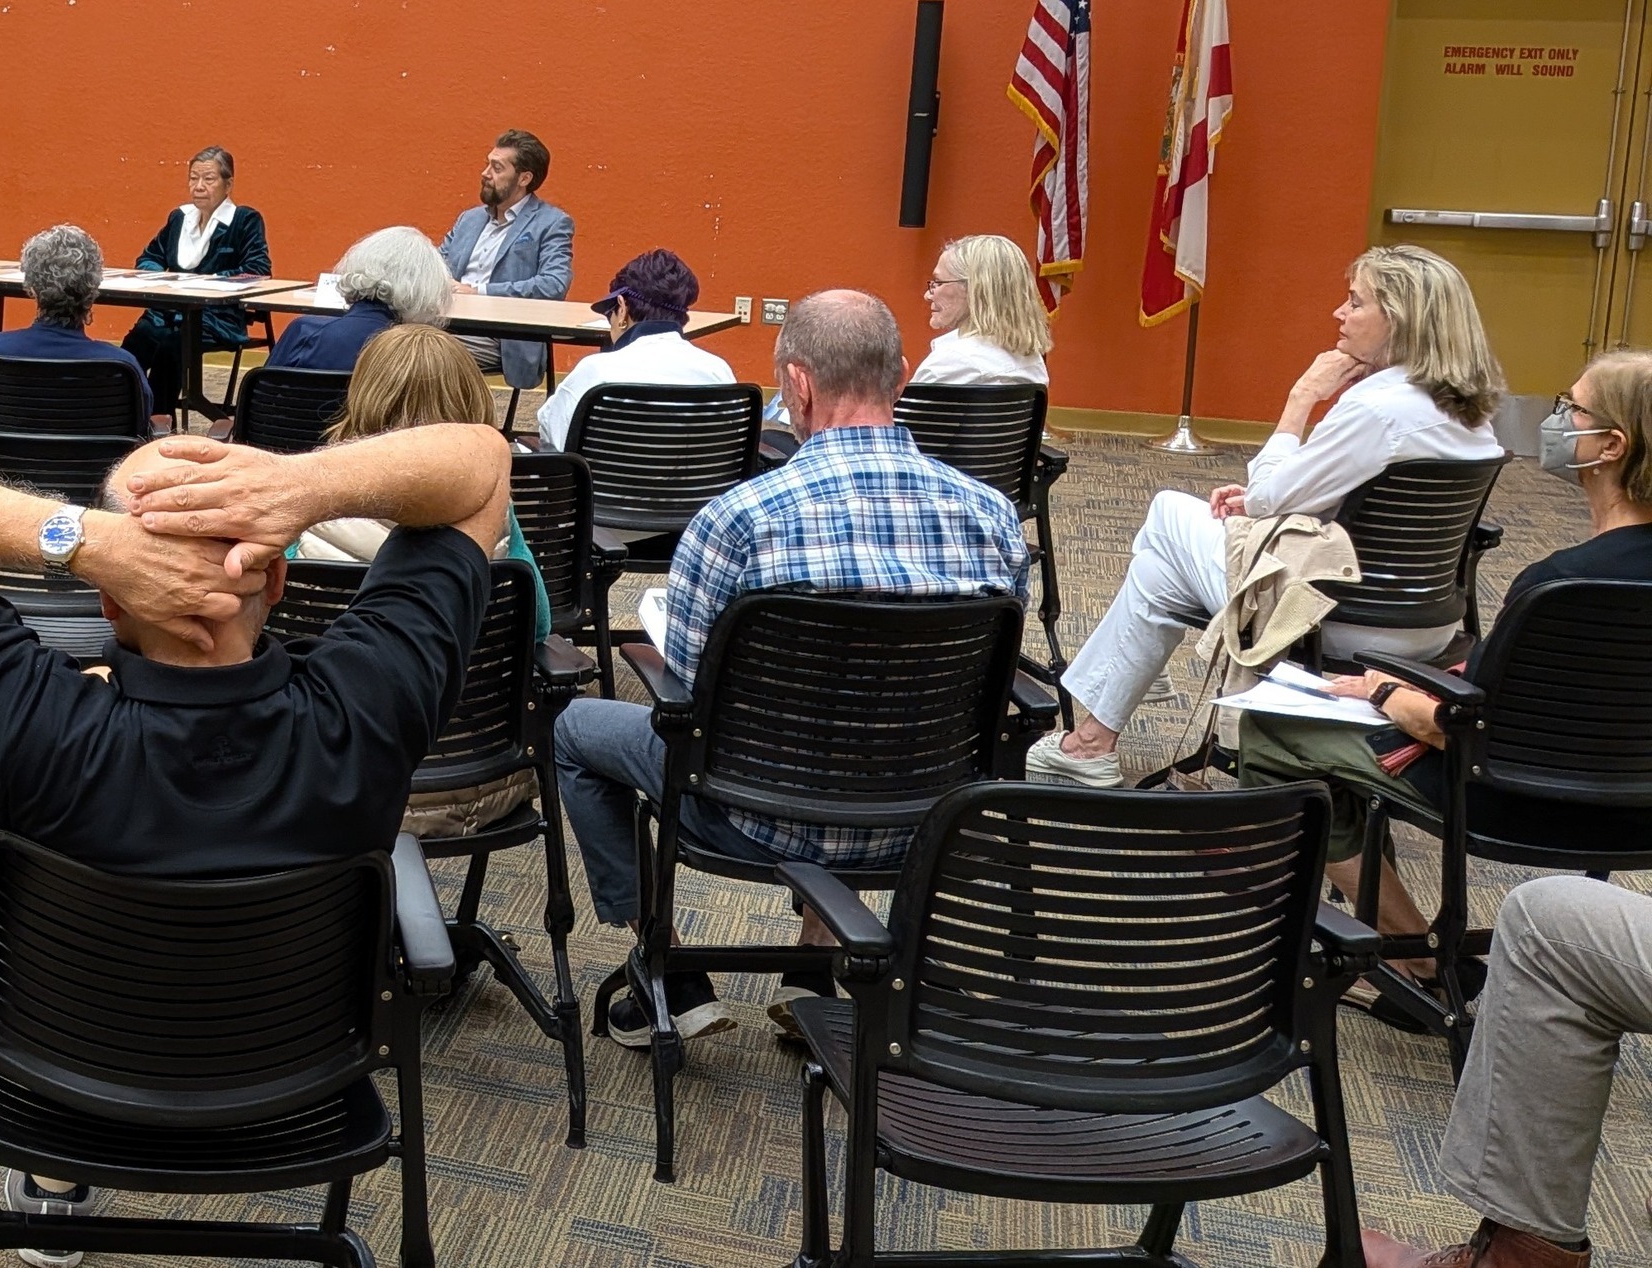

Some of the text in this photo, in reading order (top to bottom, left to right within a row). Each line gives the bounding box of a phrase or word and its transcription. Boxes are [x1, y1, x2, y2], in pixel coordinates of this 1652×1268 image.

[1444, 46, 1579, 60] EMERGENCY EXIT ONLY
[1444, 63, 1574, 77] ALARM WILL SOUND
